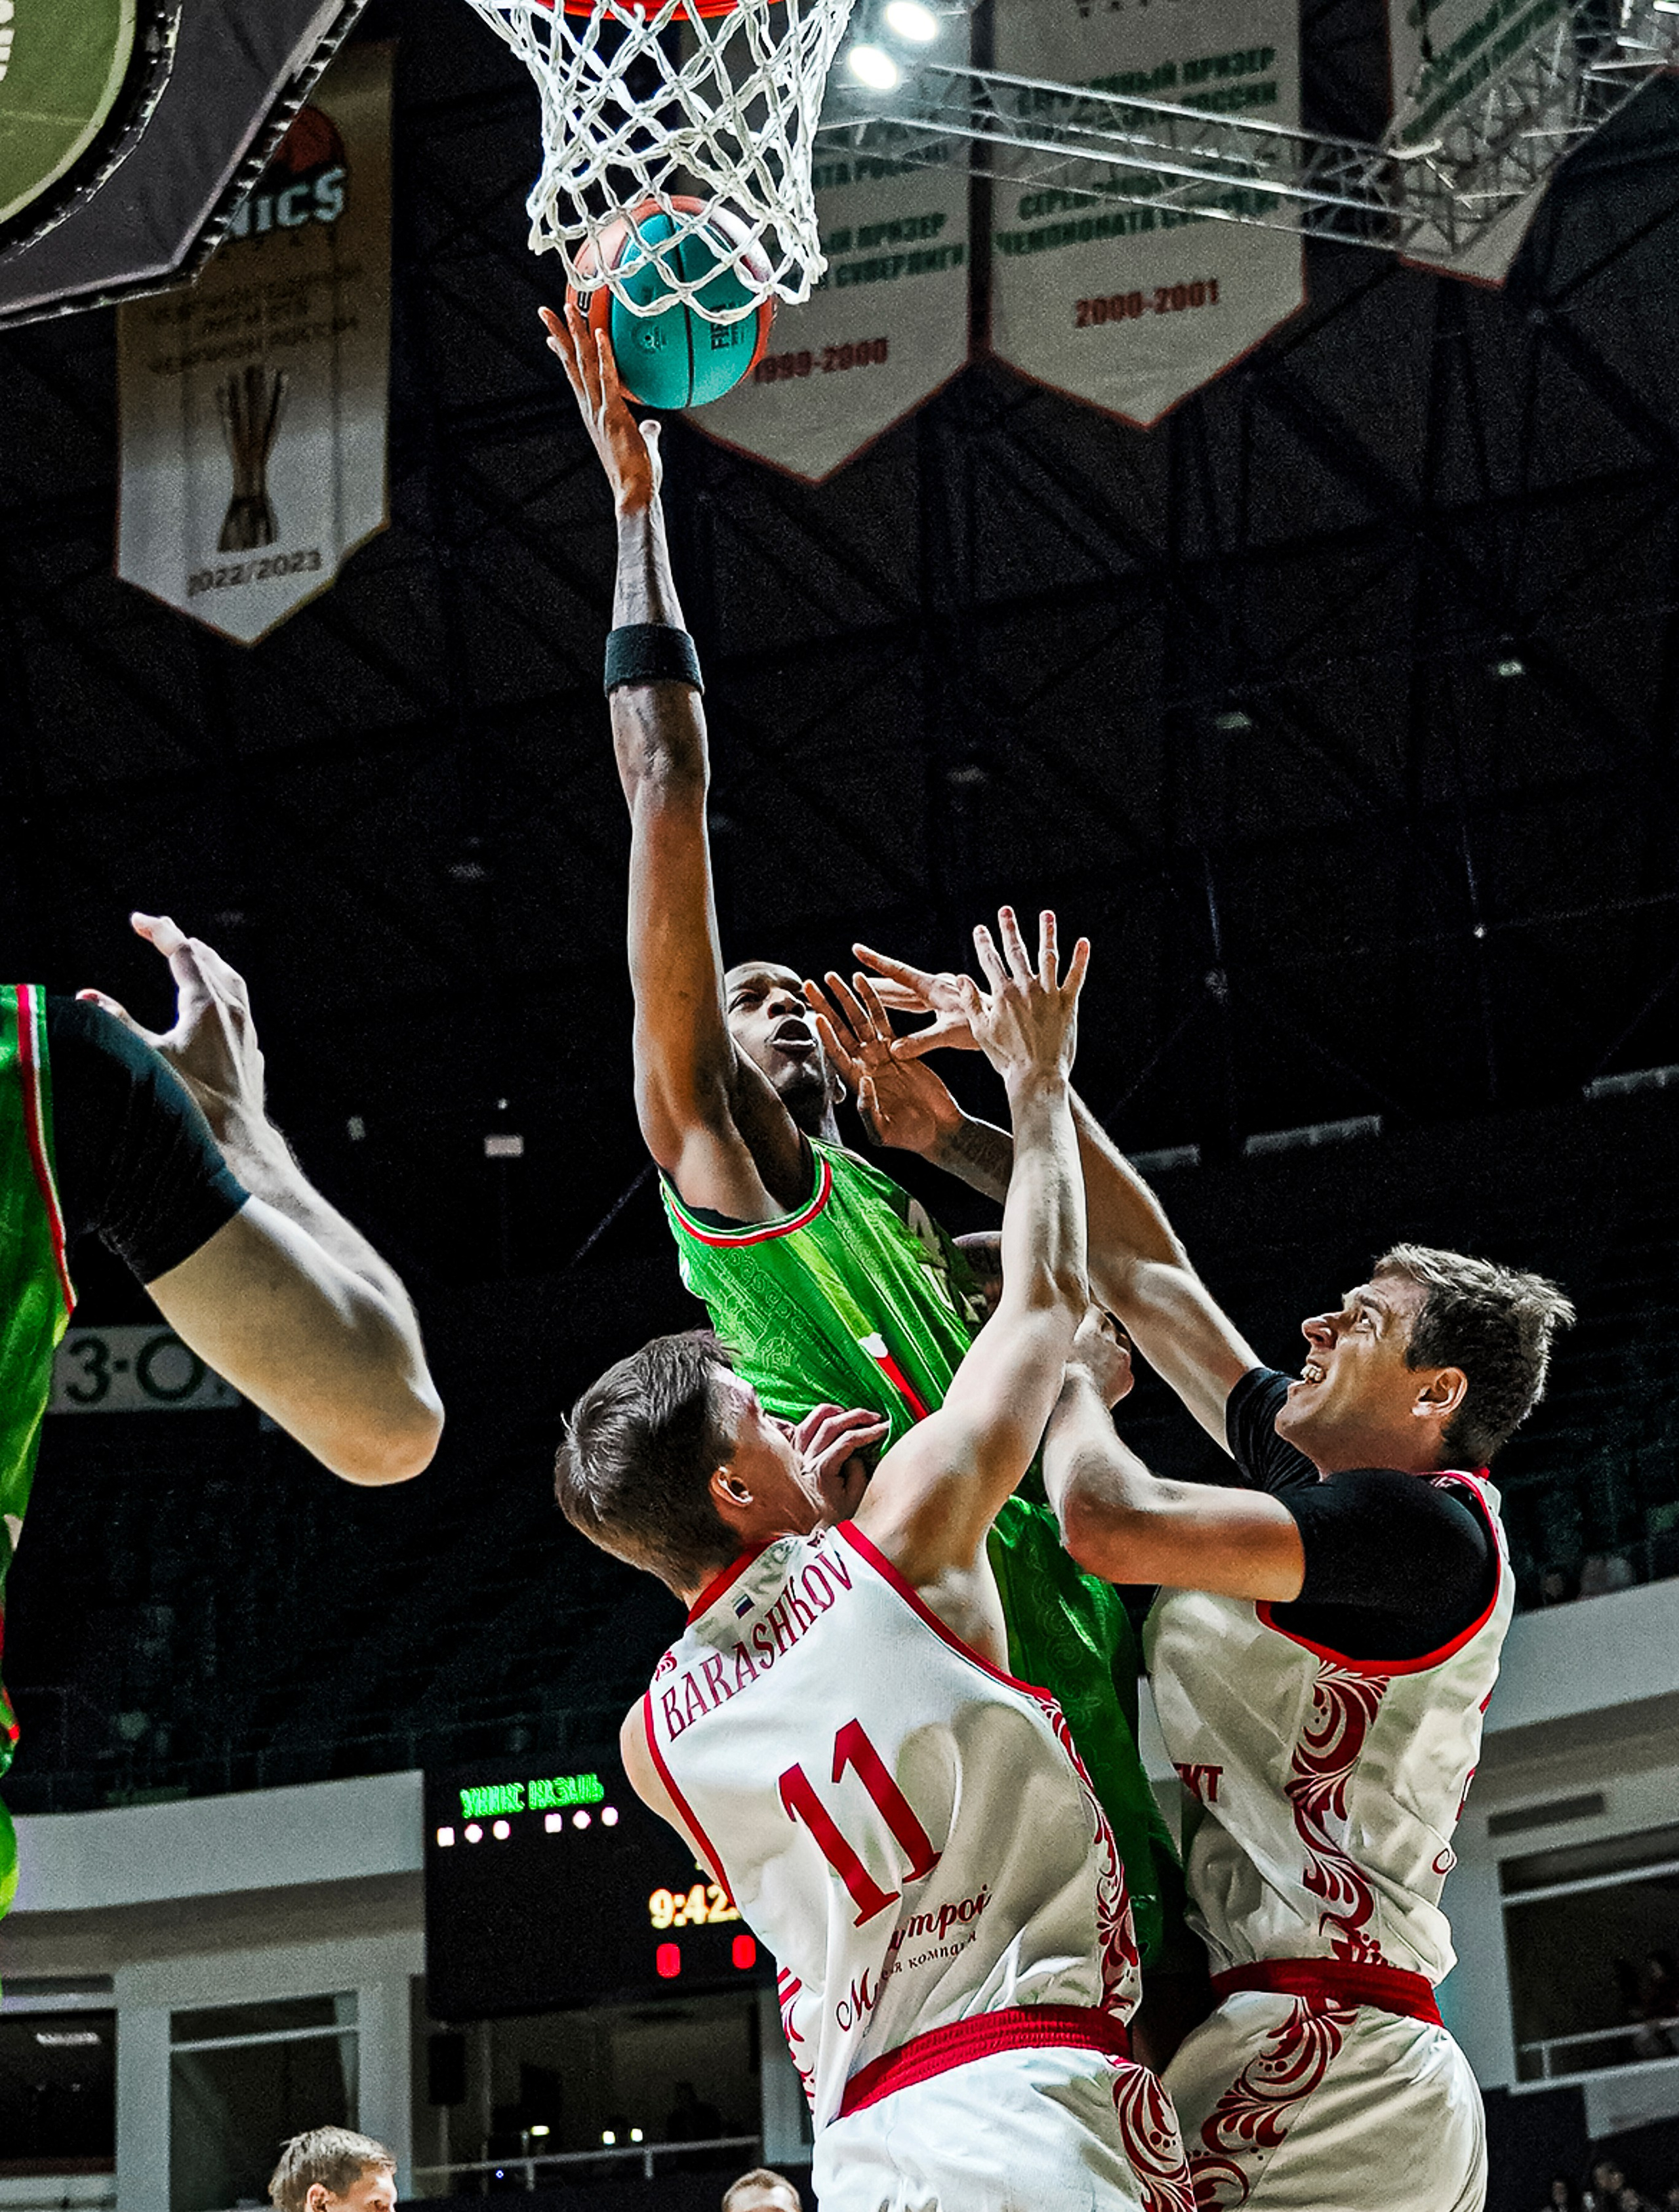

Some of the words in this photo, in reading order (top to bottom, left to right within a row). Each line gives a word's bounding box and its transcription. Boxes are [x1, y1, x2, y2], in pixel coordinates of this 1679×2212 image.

[1075, 277, 1219, 329] 2000-2001
[660, 1551, 853, 1742] BARASHKOV
[779, 1717, 943, 1928] 11
